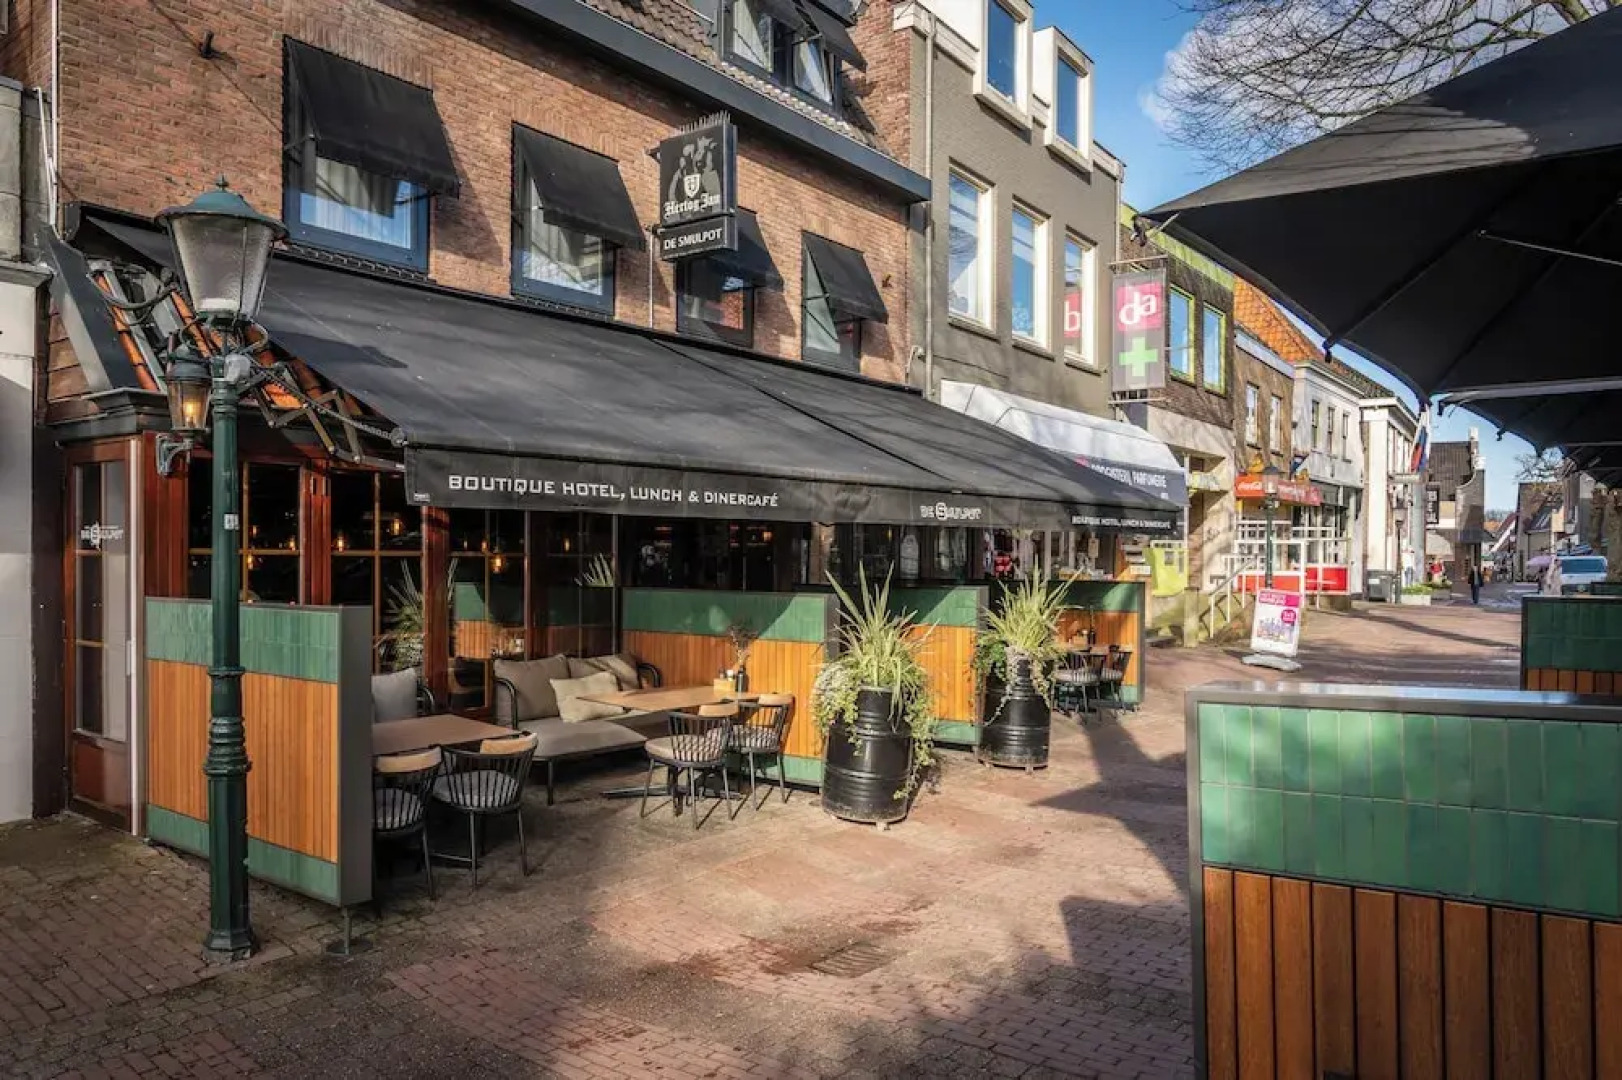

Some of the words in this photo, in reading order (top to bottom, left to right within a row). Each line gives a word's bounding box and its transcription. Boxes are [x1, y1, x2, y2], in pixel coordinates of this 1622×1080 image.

[664, 200, 700, 218] Hertog
[700, 192, 721, 209] Jan
[664, 237, 677, 251] DE
[677, 228, 723, 248] SMULPOT
[1119, 291, 1157, 325] da
[448, 474, 556, 495] BOUTIQUE
[562, 481, 626, 501] HOTEL,
[630, 485, 683, 502] LUNCH
[688, 490, 700, 503] &
[704, 491, 779, 507] DINERCAFÉ
